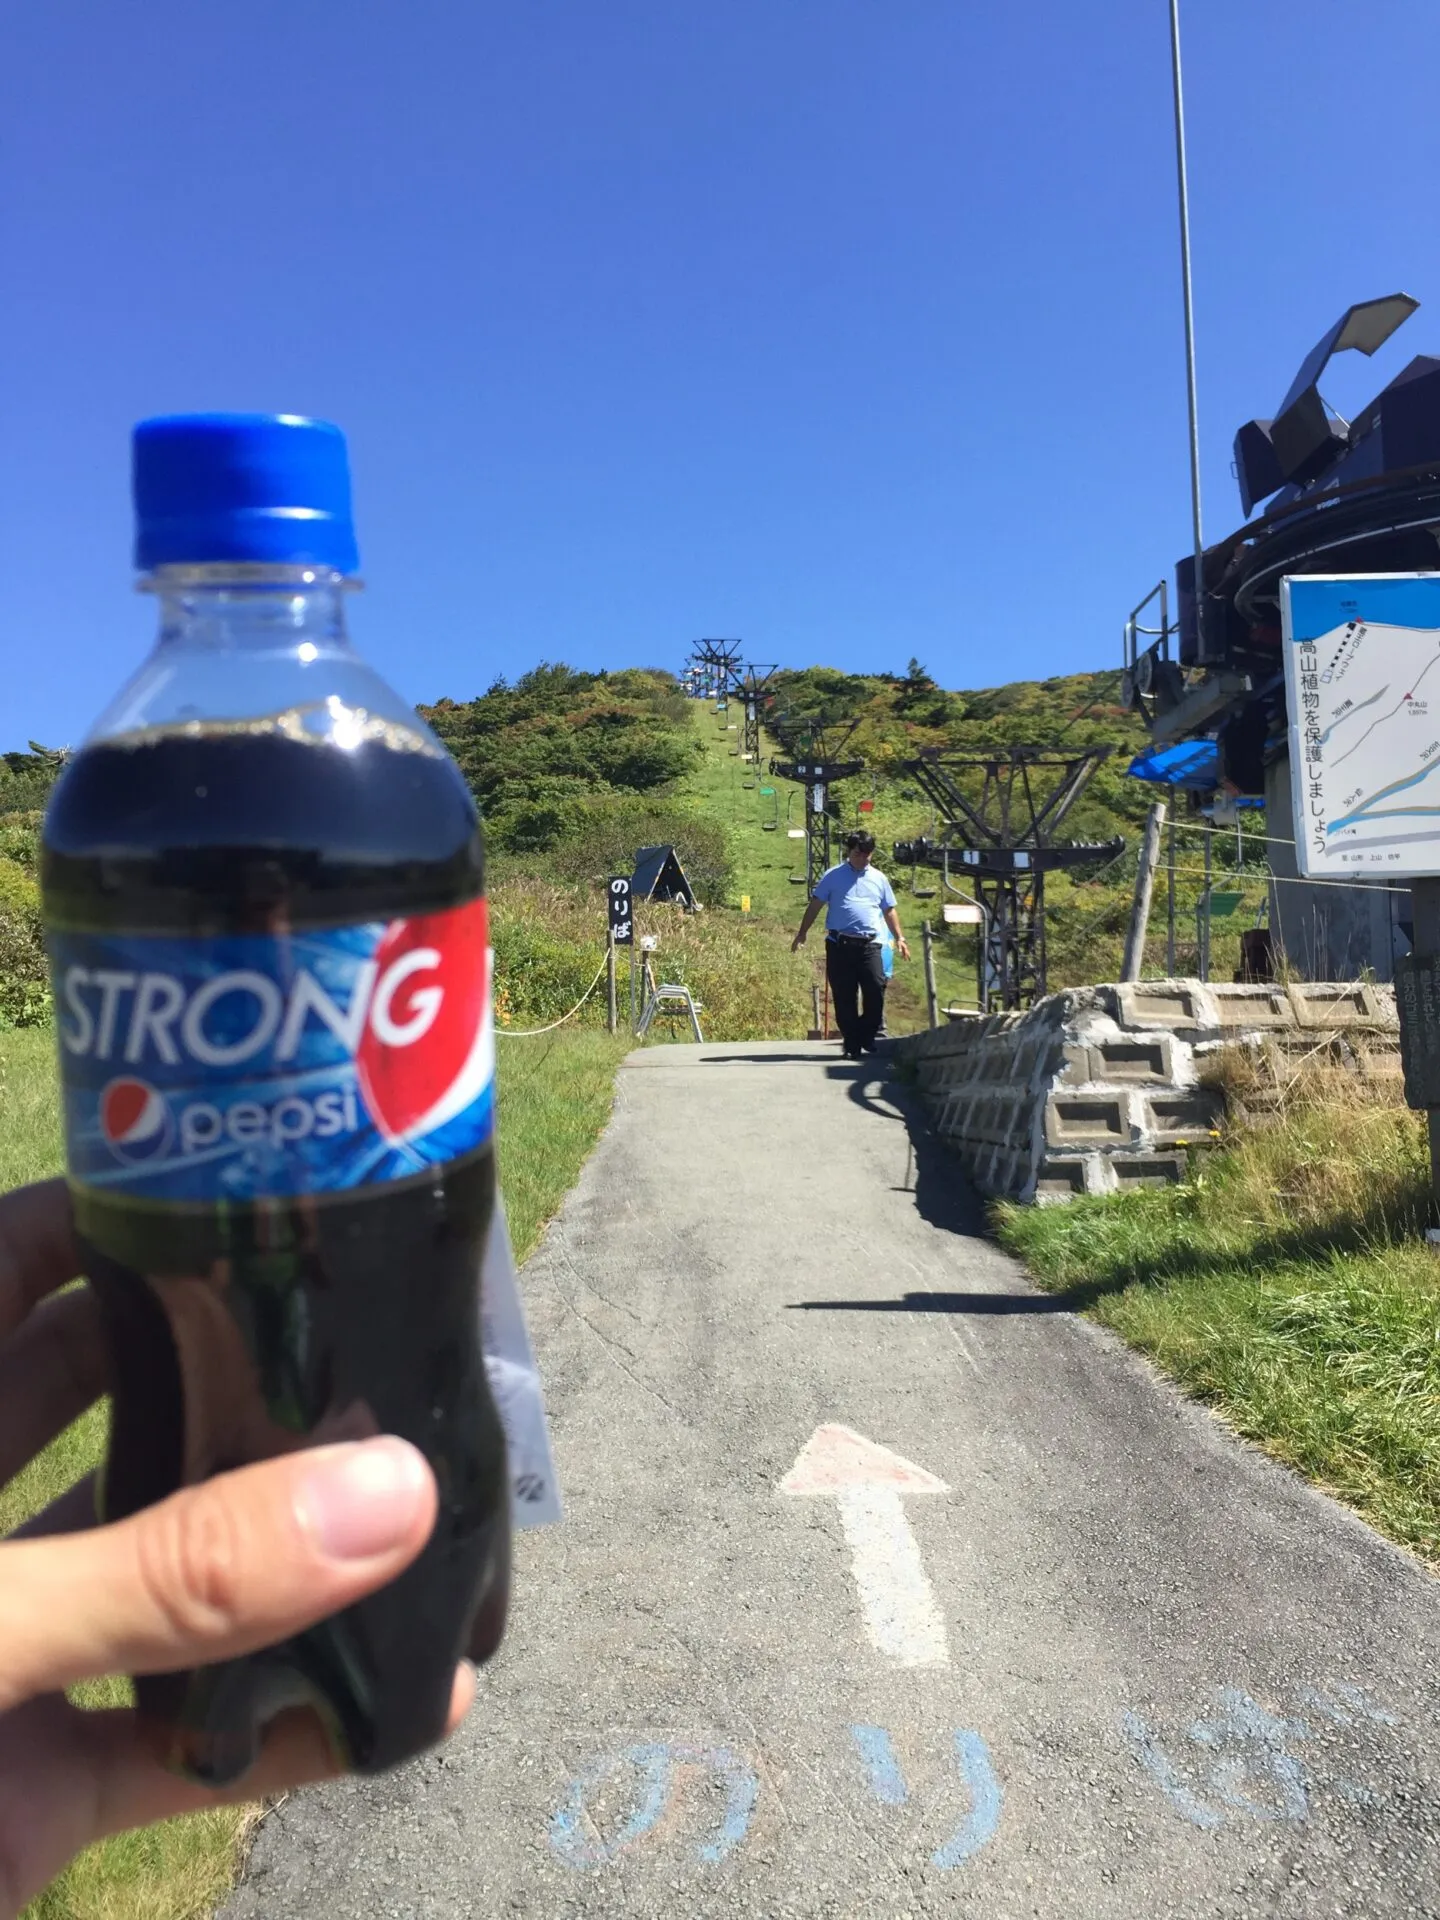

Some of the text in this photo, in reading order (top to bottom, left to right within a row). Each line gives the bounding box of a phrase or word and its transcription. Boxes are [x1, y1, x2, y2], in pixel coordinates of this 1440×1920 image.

[1299, 637, 1326, 854] 高山植物を保護しましょう
[611, 879, 632, 938] のりば
[64, 948, 445, 1066] STRONG
[180, 1086, 358, 1155] pepsi
